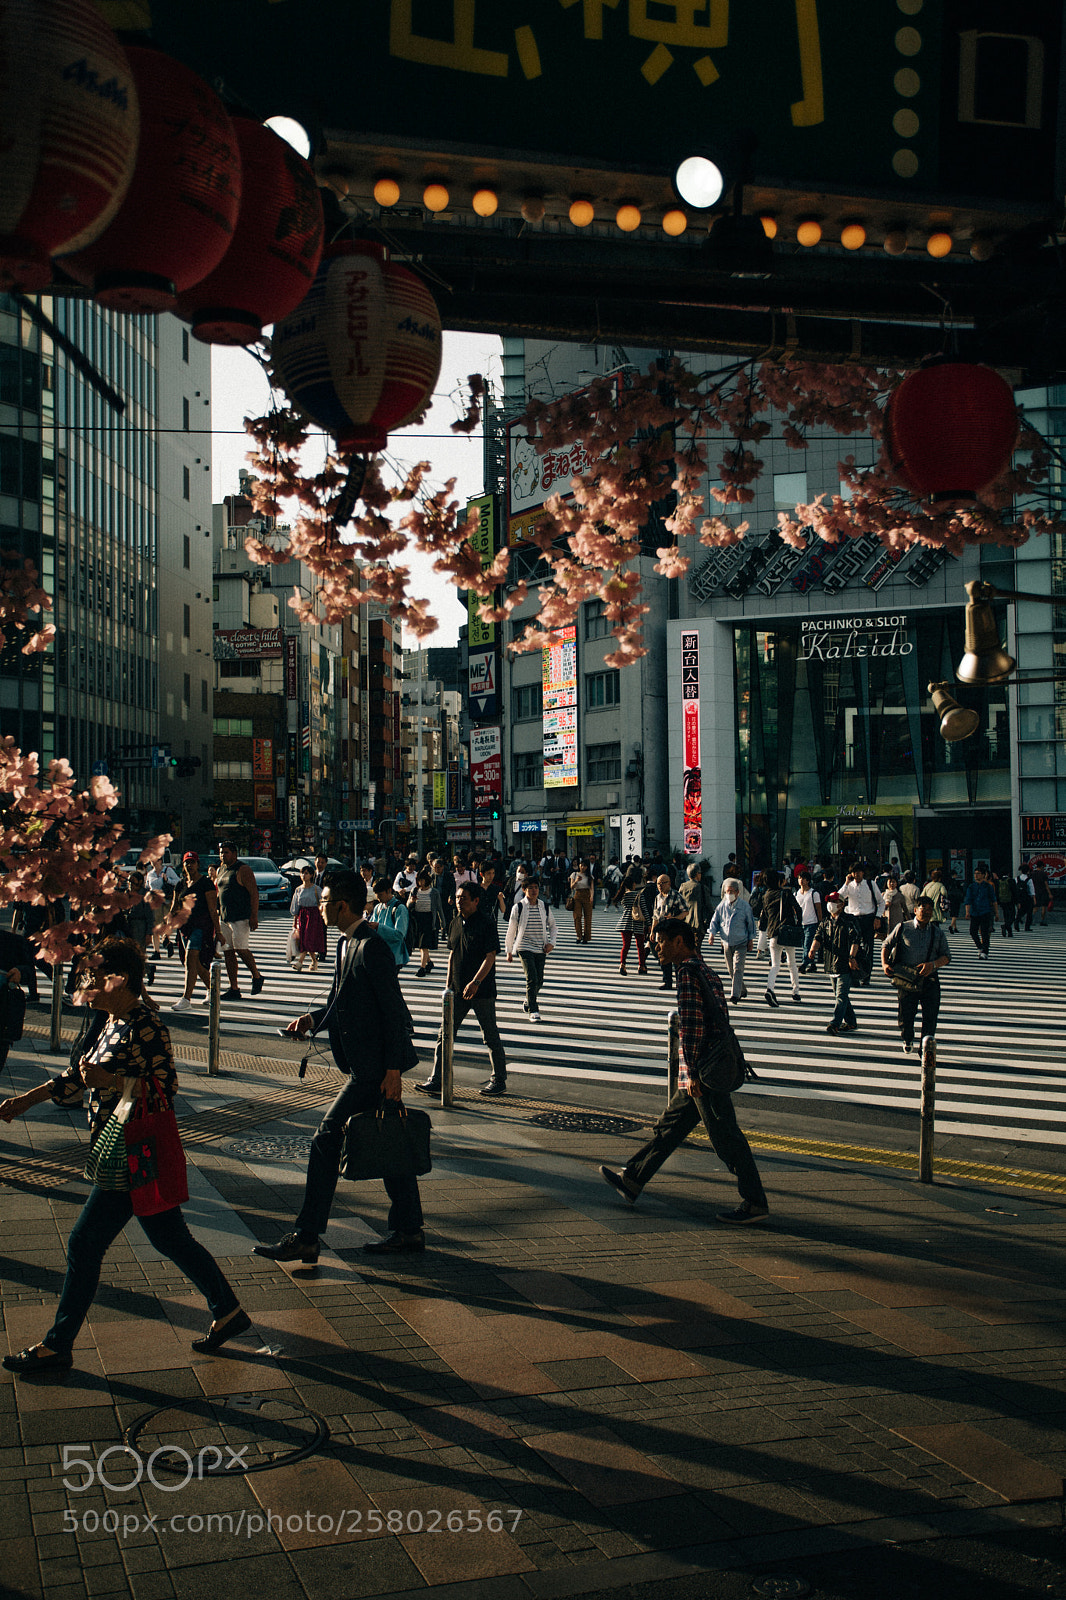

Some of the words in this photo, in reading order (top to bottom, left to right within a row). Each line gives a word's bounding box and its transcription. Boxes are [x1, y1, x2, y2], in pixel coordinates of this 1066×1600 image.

[345, 270, 371, 377] アサヒビール
[398, 316, 438, 341] Asahi
[478, 503, 491, 556] Money
[801, 619, 862, 632] PACHINKO
[865, 618, 874, 629] &
[877, 615, 907, 628] SLOT
[260, 641, 282, 649] LOLITA
[795, 628, 914, 662] Kaleido
[471, 654, 494, 684] MEX
[684, 636, 698, 699] 新台入替
[484, 769, 500, 781] 300m
[835, 804, 876, 817] Kaleido
